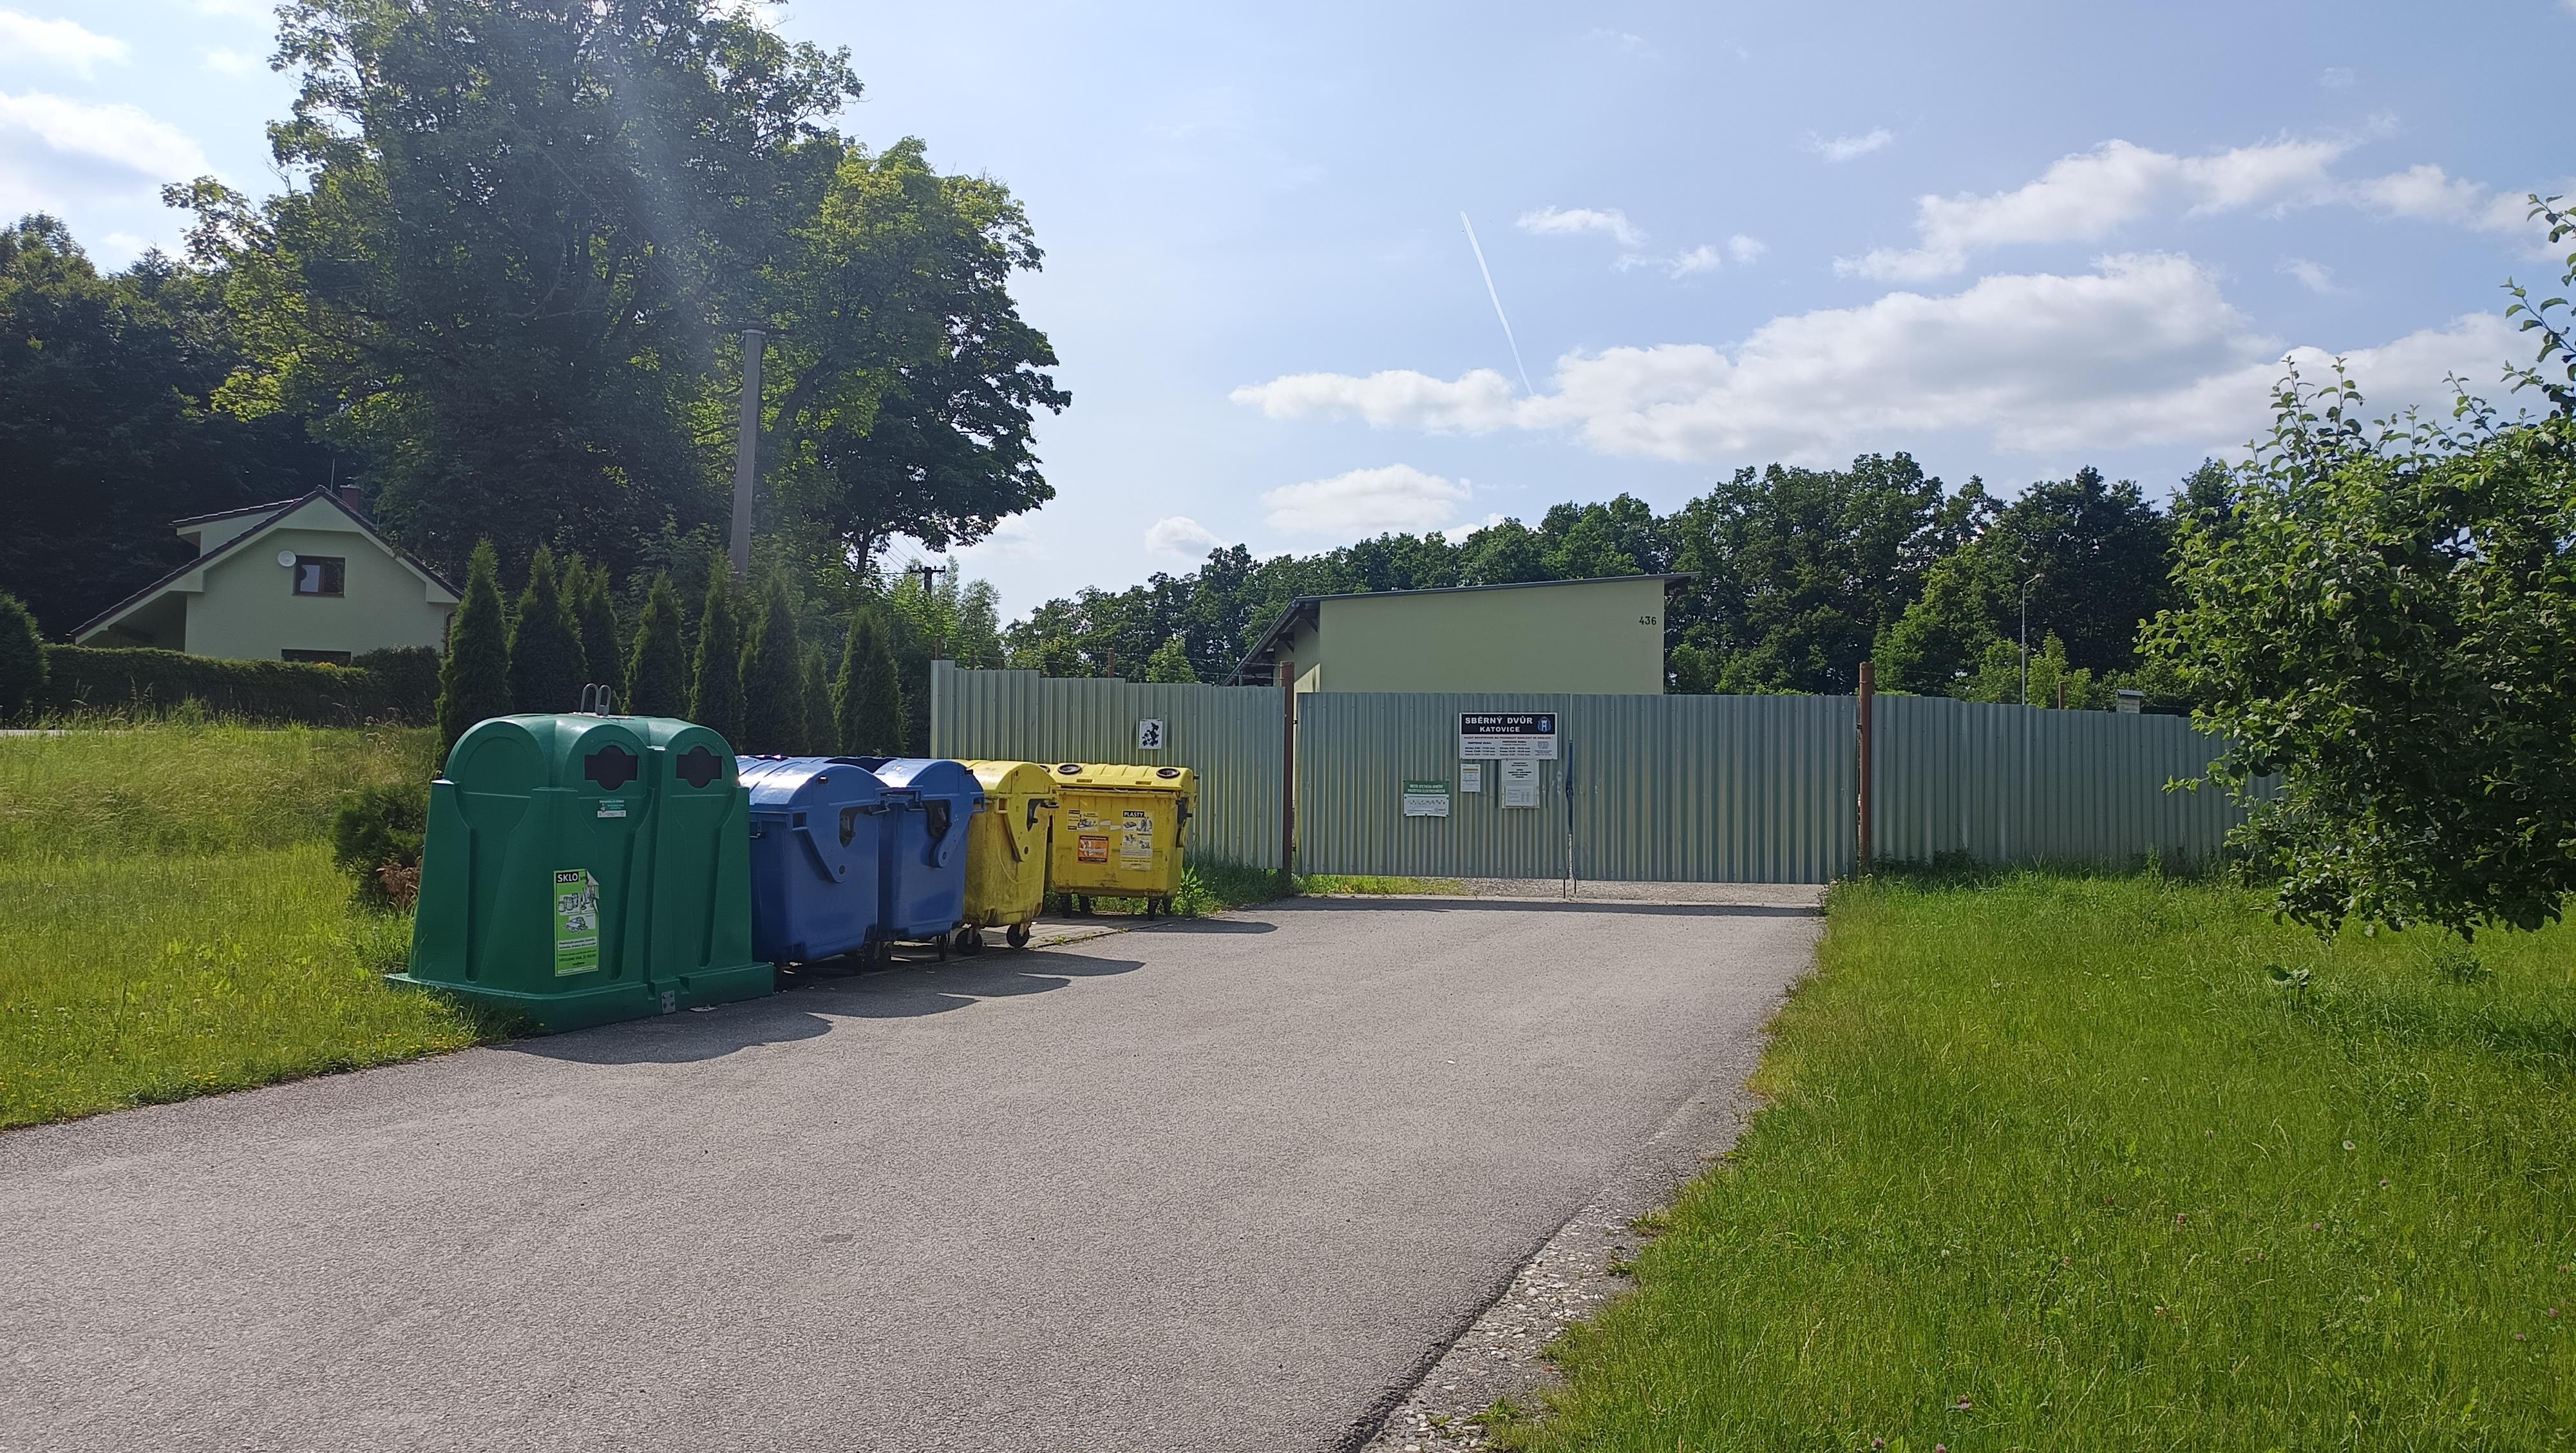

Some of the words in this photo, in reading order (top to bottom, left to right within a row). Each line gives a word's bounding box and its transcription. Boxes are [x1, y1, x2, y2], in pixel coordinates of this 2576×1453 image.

[1639, 616, 1657, 625] 436
[1465, 716, 1502, 724] SBĚRNÝ
[1507, 716, 1533, 724] DVŮR
[557, 873, 578, 882] SKLO
